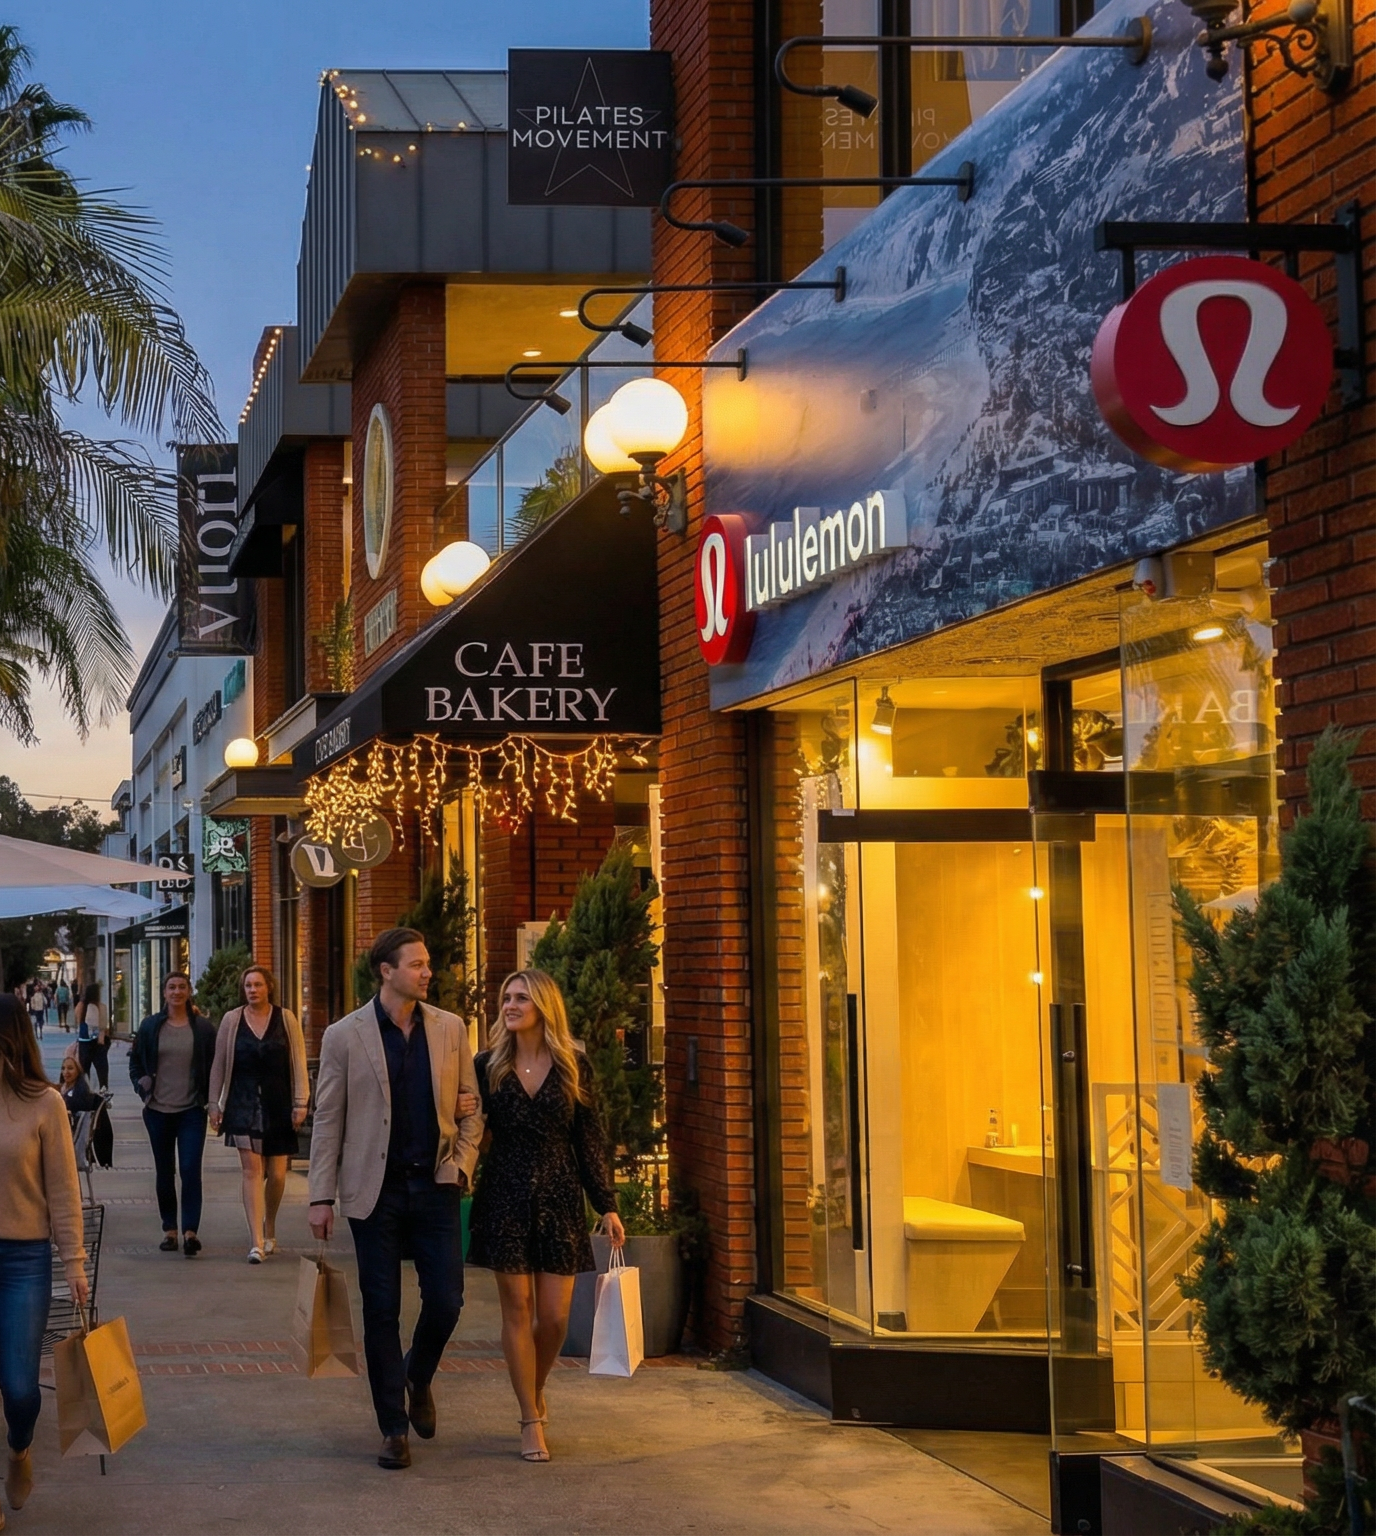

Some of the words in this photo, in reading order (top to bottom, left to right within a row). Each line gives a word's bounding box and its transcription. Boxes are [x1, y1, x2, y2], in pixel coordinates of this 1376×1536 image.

[536, 105, 644, 126] PILATES
[512, 128, 668, 149] MOVEMENT
[745, 490, 885, 611] lululemon
[454, 641, 585, 678] CAFE
[424, 687, 618, 722] BAKERY
